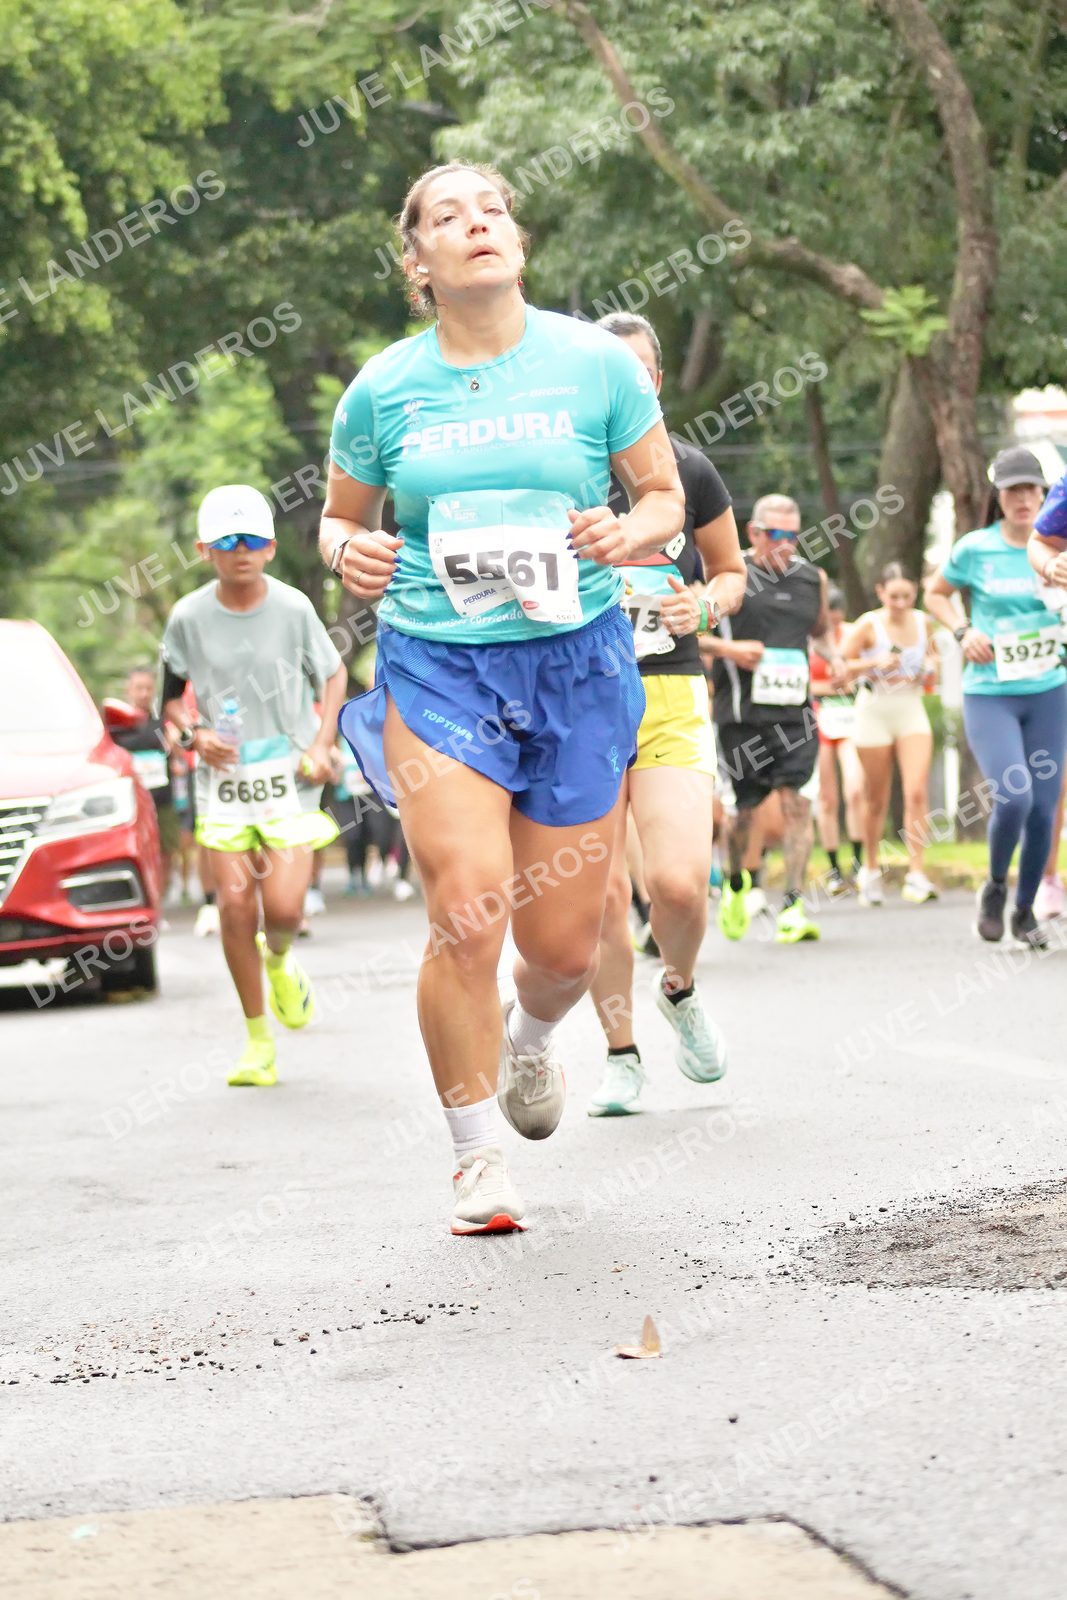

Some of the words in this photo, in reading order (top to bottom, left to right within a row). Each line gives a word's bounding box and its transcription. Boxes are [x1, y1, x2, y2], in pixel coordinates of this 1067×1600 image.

[529, 385, 579, 398] BROOKS
[401, 410, 576, 457] PERDURA
[444, 550, 559, 591] 5561
[463, 588, 498, 606] PERDURA
[1002, 639, 1057, 663] 3922
[218, 775, 287, 803] 6685
